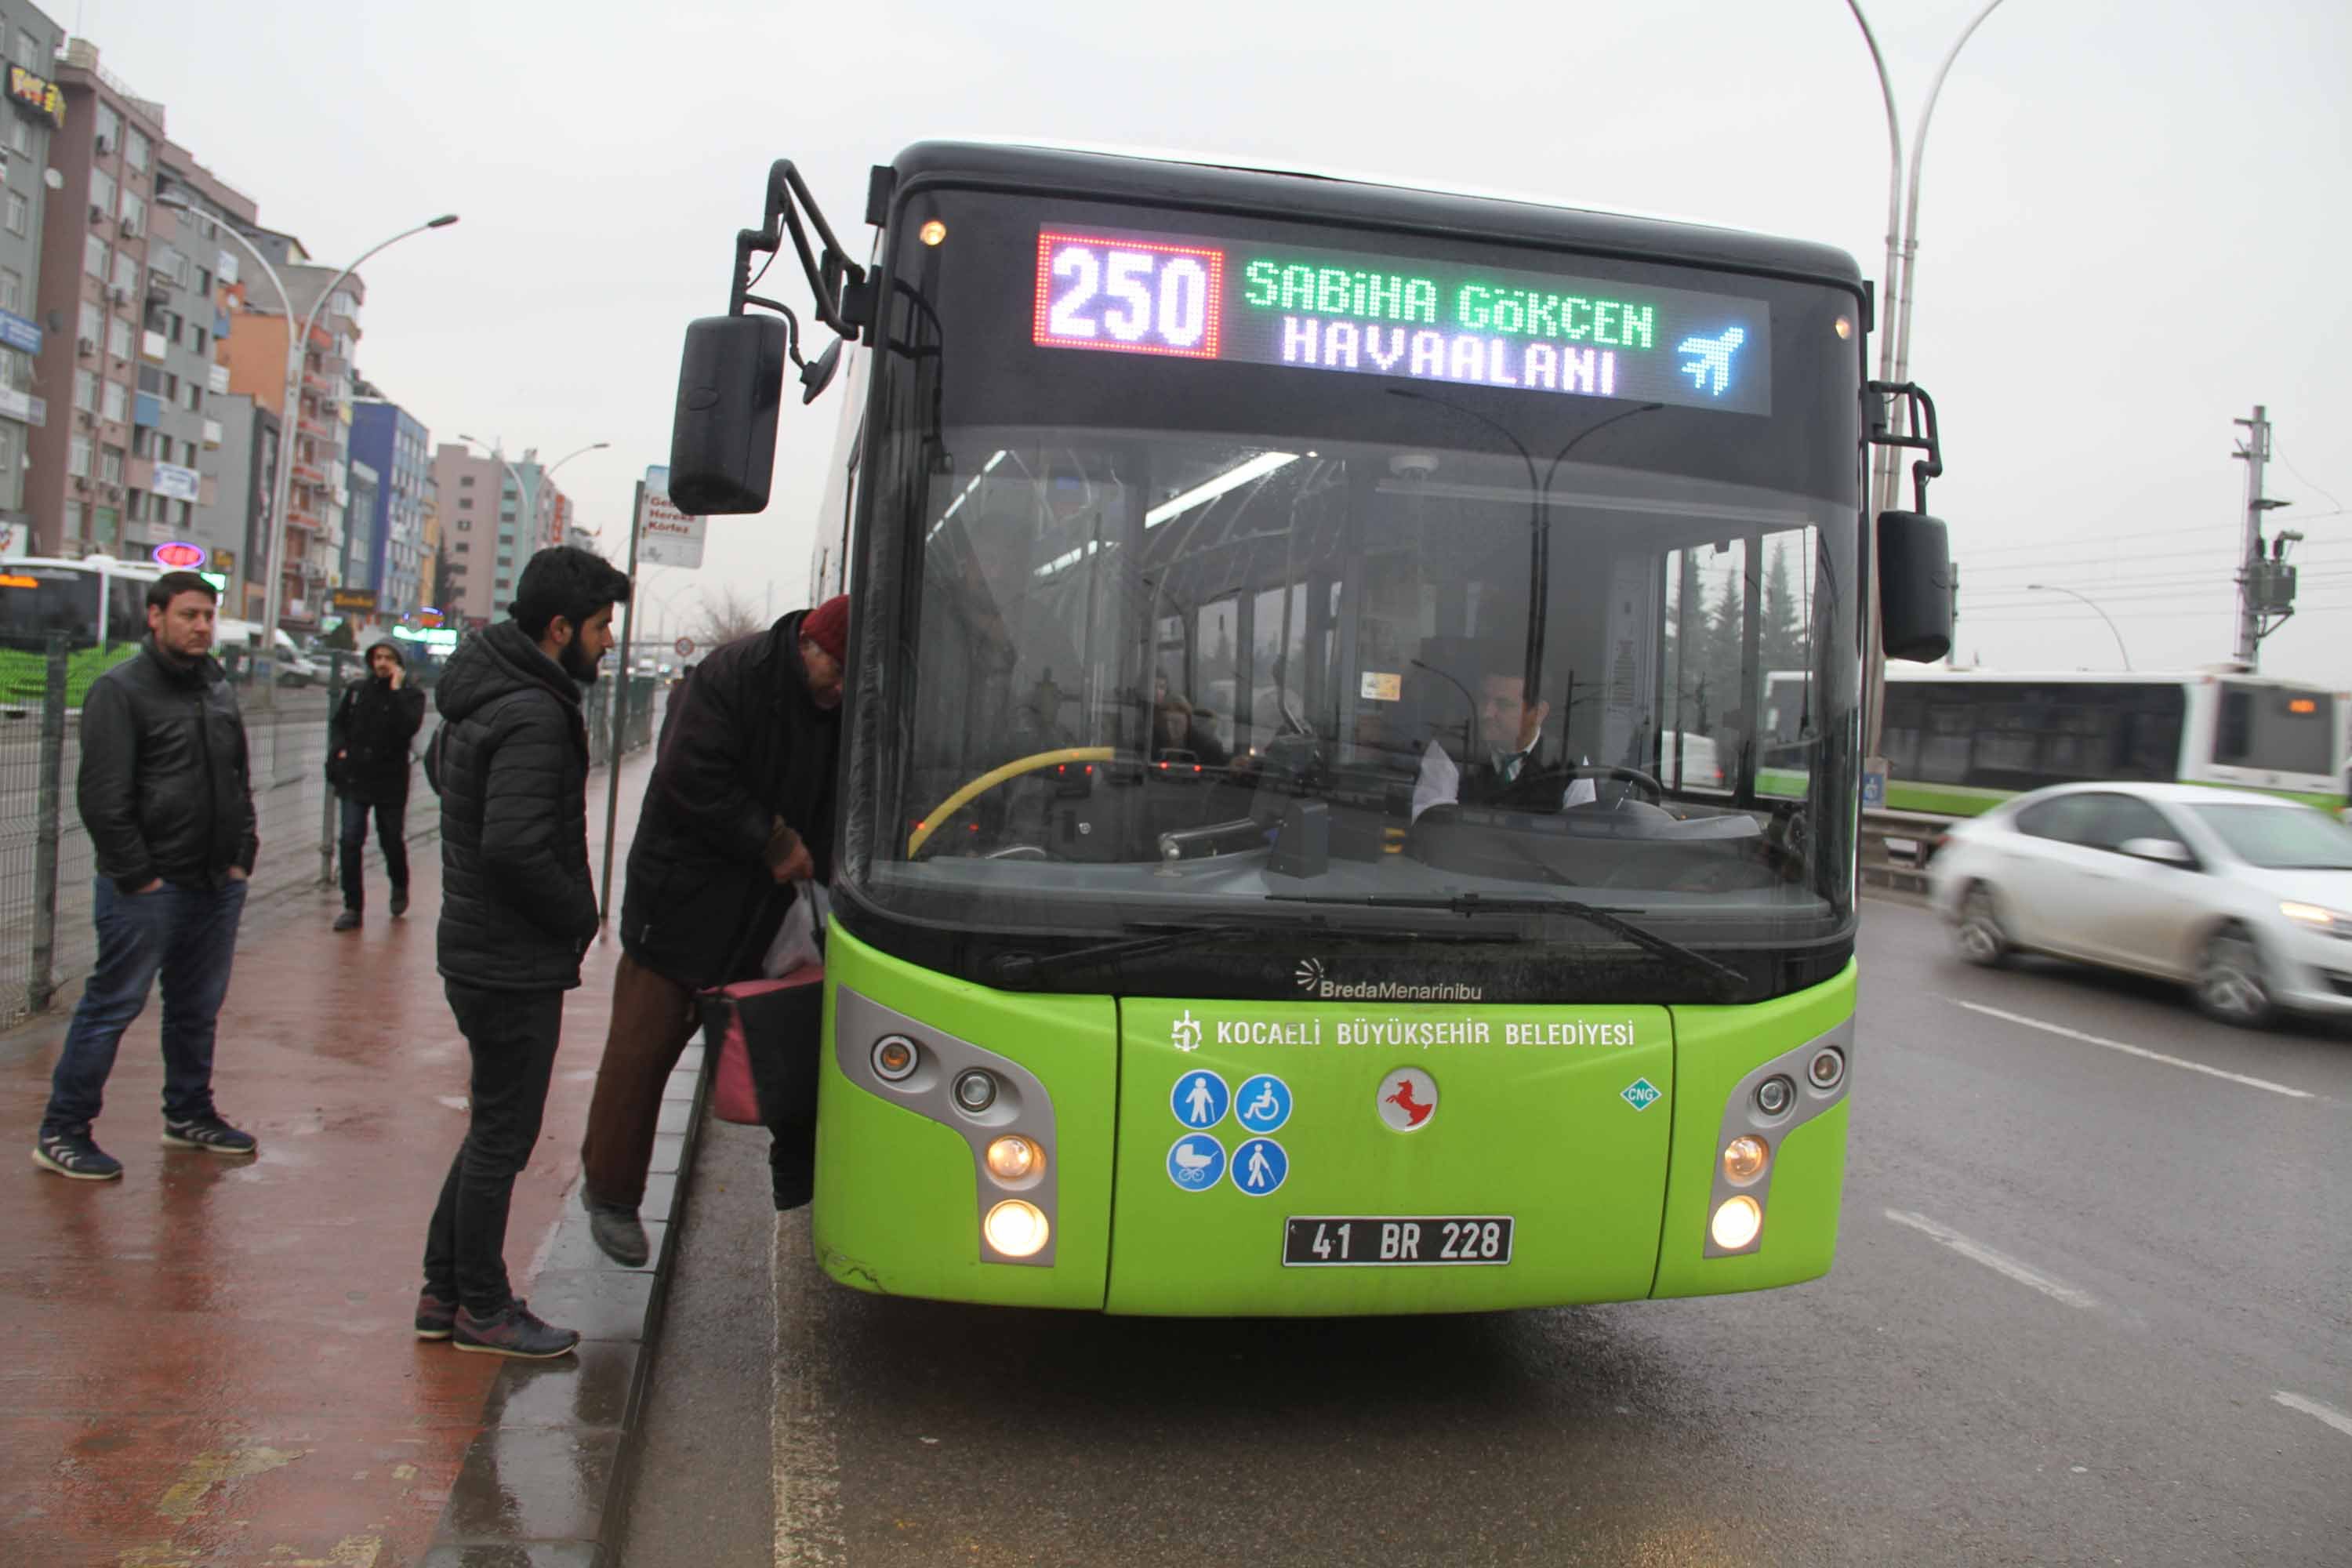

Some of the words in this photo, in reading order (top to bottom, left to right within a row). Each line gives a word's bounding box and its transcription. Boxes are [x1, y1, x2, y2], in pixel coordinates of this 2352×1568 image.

[1051, 246, 1206, 348] 250
[1283, 316, 1616, 395] HAVAALANI
[1320, 980, 1482, 1000] BredaMenarinibu
[1217, 1018, 1321, 1045] KOCAELİ
[1337, 1018, 1490, 1048] BÜYÜKŞEHİR
[1505, 1018, 1635, 1046] BELEDİYESİ
[1628, 1087, 1654, 1101] CNG
[1312, 1223, 1352, 1259] 41
[1380, 1223, 1421, 1259] BR
[1439, 1222, 1501, 1258] 228
